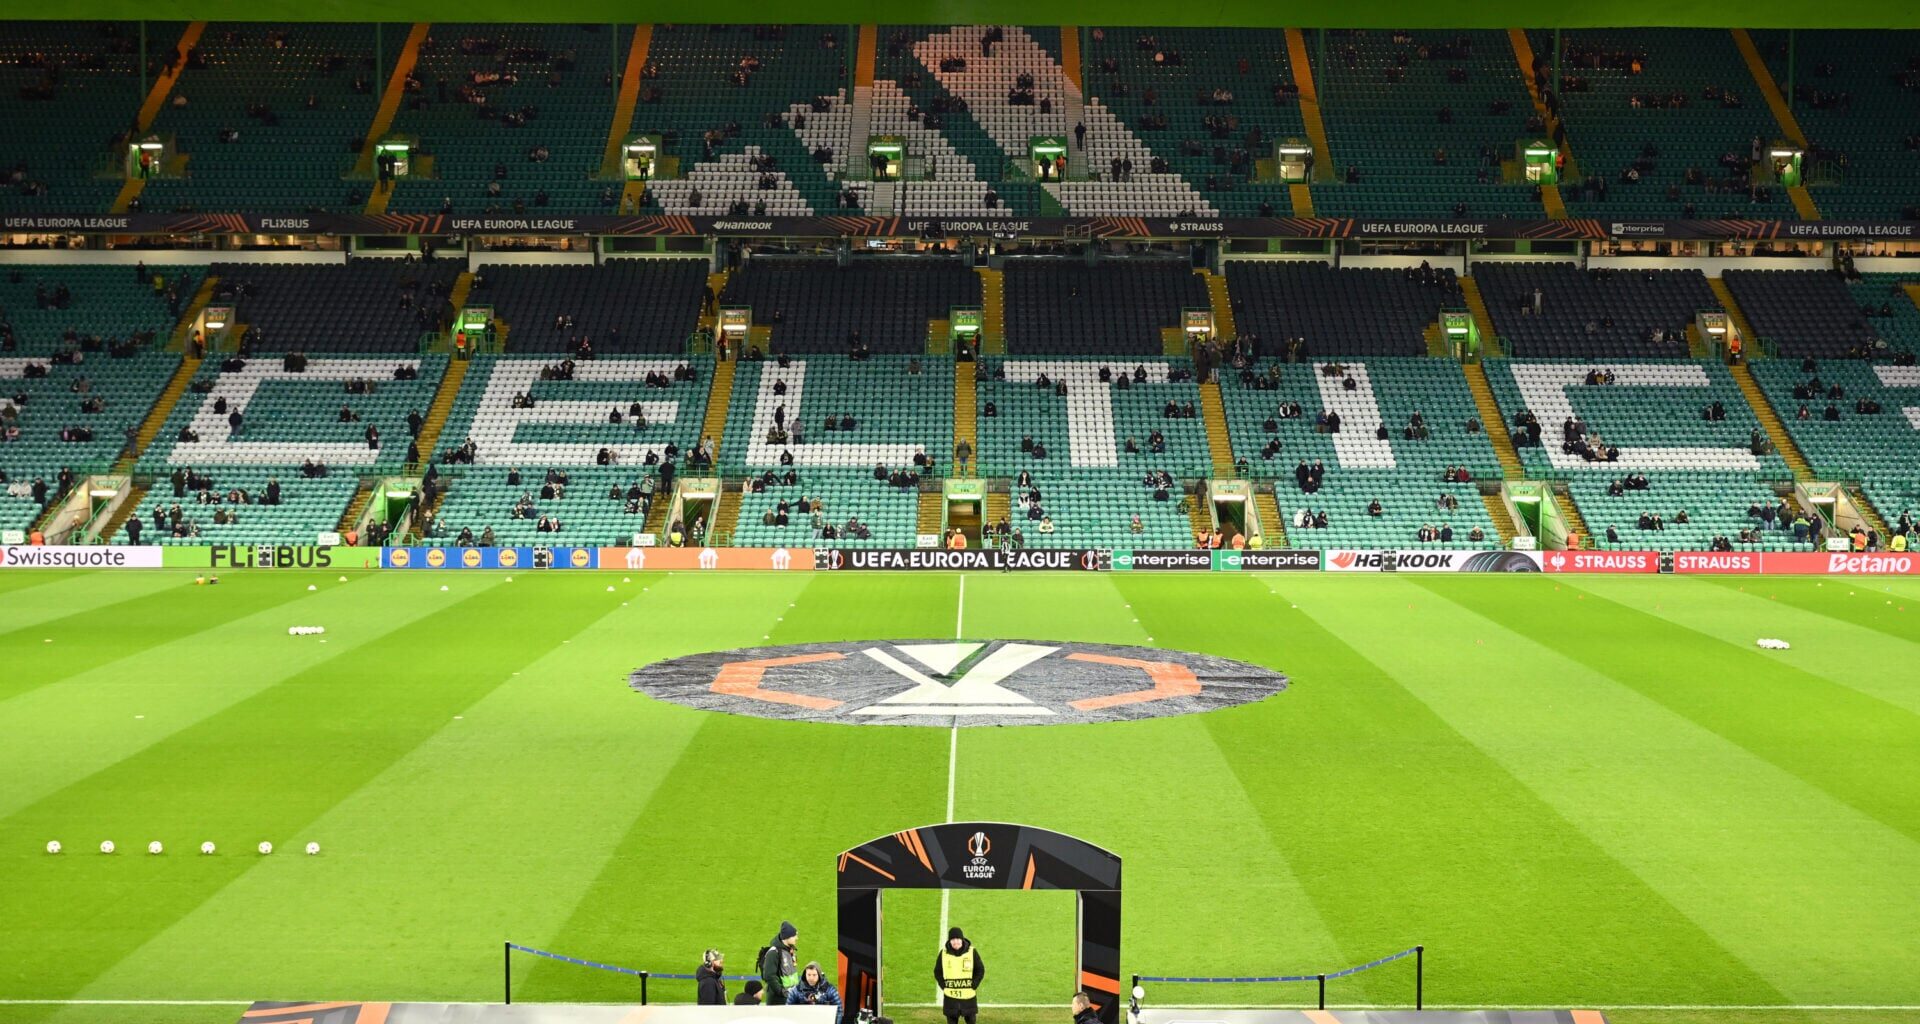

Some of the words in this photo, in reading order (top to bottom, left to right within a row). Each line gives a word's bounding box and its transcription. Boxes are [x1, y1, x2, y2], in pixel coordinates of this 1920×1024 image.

[5, 218, 35, 228] UEFA
[37, 218, 82, 228] EUROPA
[84, 218, 127, 228] LEAGUE
[452, 220, 482, 230] UEFA
[484, 220, 528, 230] EUROPA
[531, 220, 574, 230] LEAGUE
[908, 221, 937, 232] UEF
[940, 221, 984, 232] EUROPA
[987, 221, 1029, 232] LEAGUE
[1180, 222, 1223, 232] STRAUSS
[1362, 224, 1392, 234] UEFA
[1394, 224, 1438, 234] EUROPA
[1440, 224, 1484, 234] LEAGUE
[1790, 226, 1819, 236] UEFA
[1821, 226, 1866, 236] EUROPA
[1868, 226, 1911, 236] LEAGUE
[7, 546, 126, 568] Swissquote
[852, 552, 905, 568] UEFA
[910, 552, 989, 568] EUROPA
[1118, 555, 1210, 569] enterprise
[1227, 555, 1319, 569] enterprise
[1574, 555, 1646, 569] STRAUSS
[1679, 556, 1751, 570] STRAUSS
[1828, 553, 1911, 573] Betano
[963, 865, 996, 873] EUROPA
[944, 979, 973, 988] TEWAR
